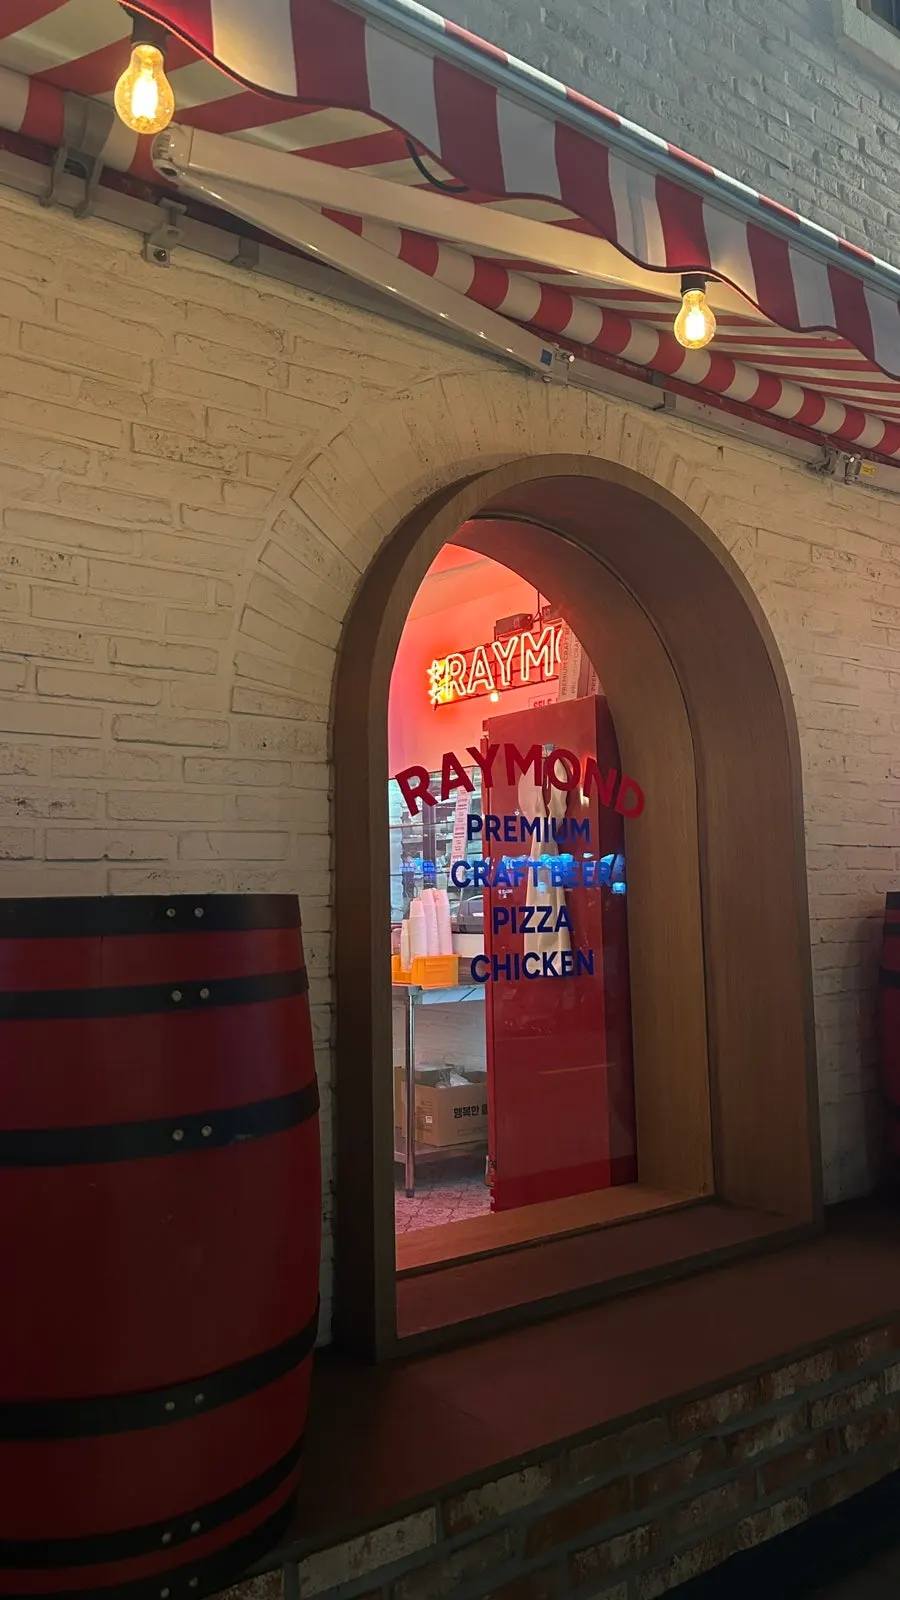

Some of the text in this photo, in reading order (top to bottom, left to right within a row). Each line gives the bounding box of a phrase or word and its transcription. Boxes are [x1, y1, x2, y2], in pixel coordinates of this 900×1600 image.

[444, 626, 563, 700] RAYM
[395, 743, 645, 819] RAYMOND
[467, 814, 590, 844] PREMIUM
[451, 860, 613, 889] CRAFT BEER
[493, 905, 574, 934] PIZZA
[470, 950, 594, 982] CHICKEN
